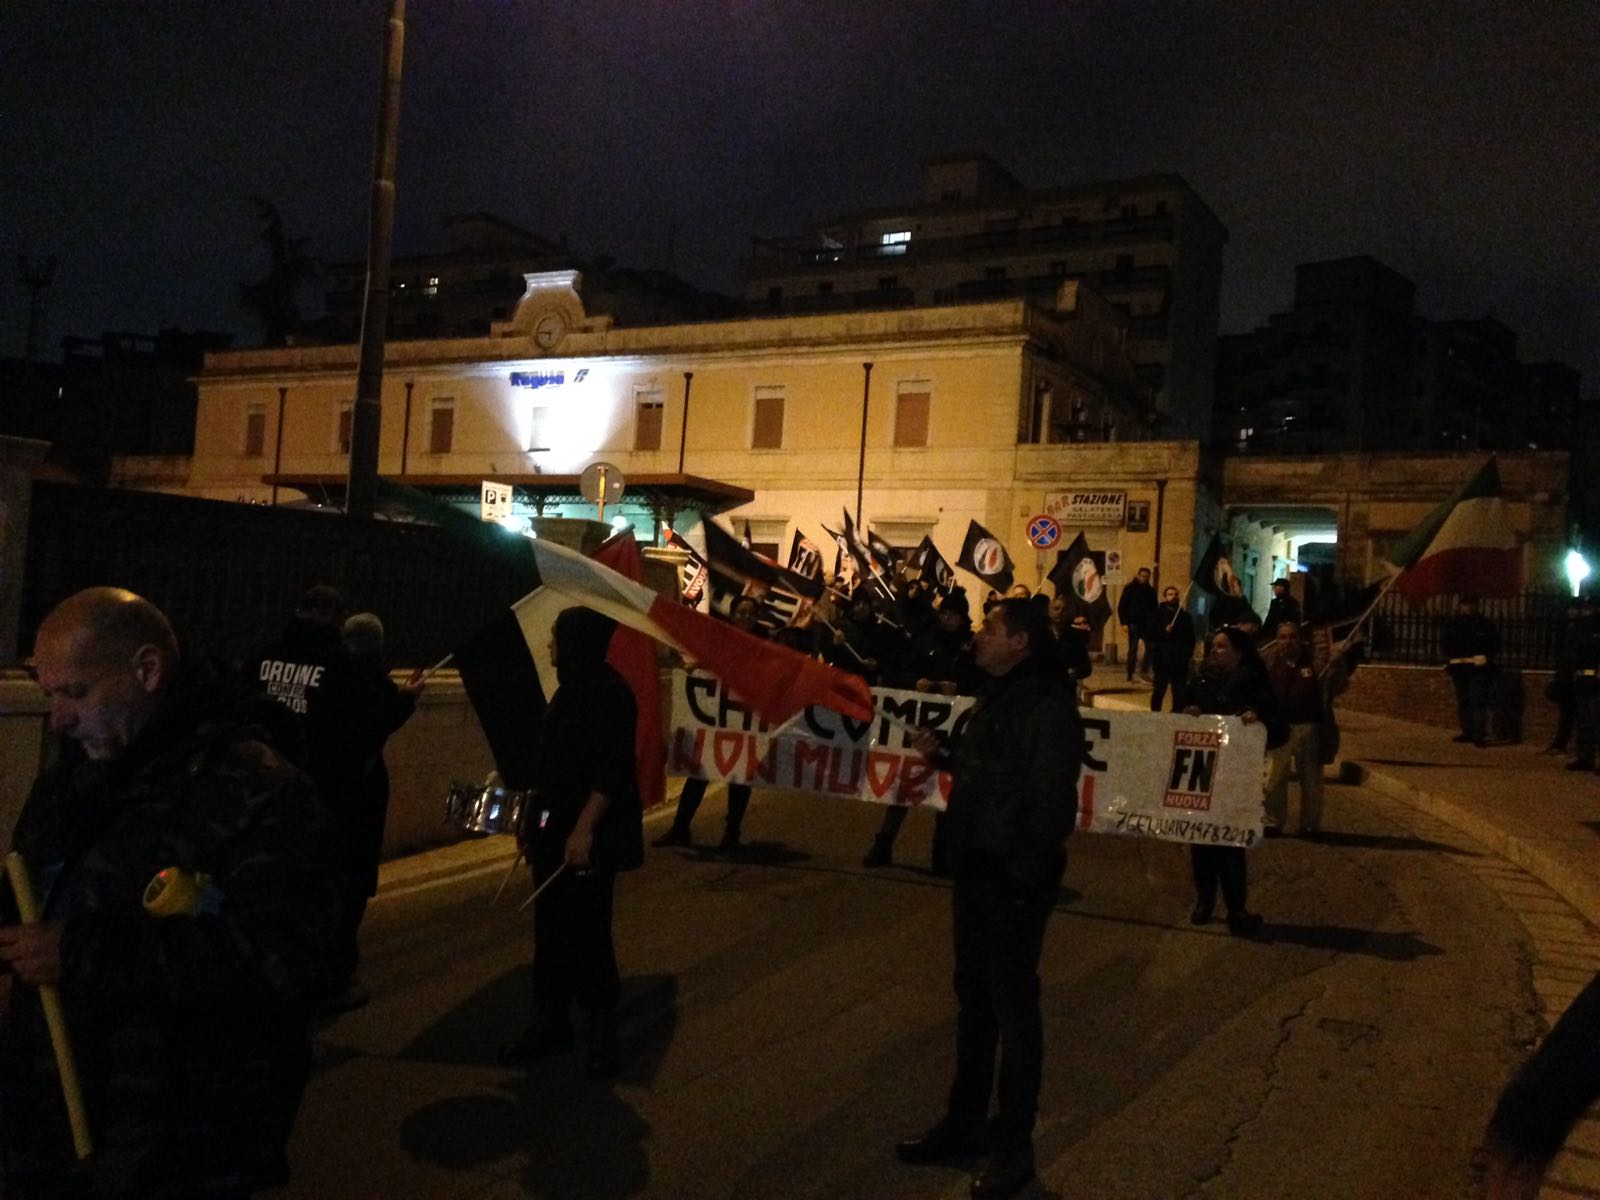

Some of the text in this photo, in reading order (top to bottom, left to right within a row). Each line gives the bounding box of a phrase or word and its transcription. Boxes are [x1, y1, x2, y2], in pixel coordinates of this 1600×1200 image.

[1072, 494, 1122, 505] STAZIONE
[260, 660, 325, 688] ORDINE
[1177, 732, 1219, 746] FORZA
[1169, 749, 1217, 793] FN
[1166, 794, 1209, 810] NUOVA
